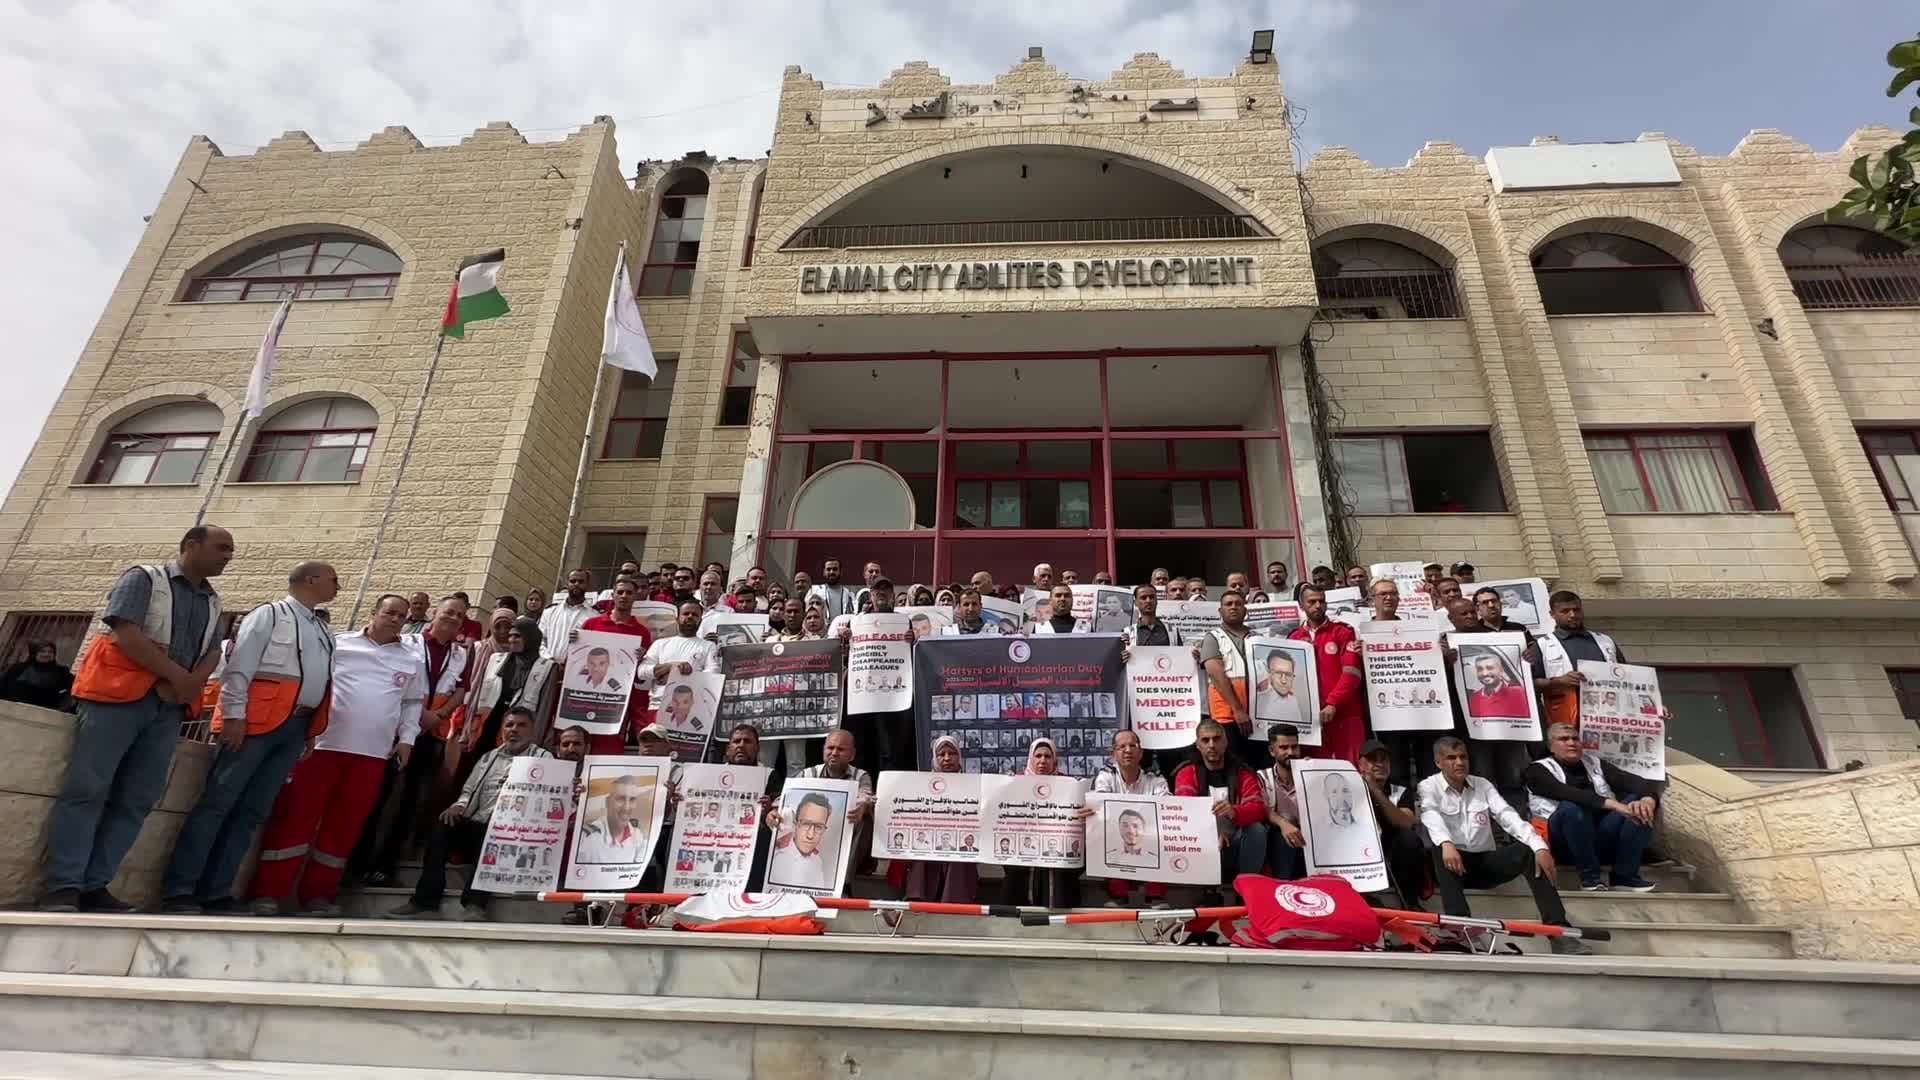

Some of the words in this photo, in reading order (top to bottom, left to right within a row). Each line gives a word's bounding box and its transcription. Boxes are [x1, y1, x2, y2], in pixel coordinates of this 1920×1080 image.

[894, 263, 951, 291] CITY
[954, 260, 1063, 290] ABILITIES
[1073, 257, 1253, 288] DEVELOPMENT
[853, 632, 904, 643] RELEASE
[1366, 641, 1432, 651] RELEASE
[853, 651, 888, 659] FORCIBLY
[852, 658, 905, 666] DISAPPEARED
[943, 666, 982, 676] Martyrs
[985, 665, 995, 674] of
[999, 663, 1074, 674] Humanitarian
[1078, 663, 1104, 673] Duty
[1370, 669, 1437, 677] DISAPPEARED
[1136, 699, 1195, 707] MEDICS
[1583, 714, 1618, 724] THEIR
[1622, 718, 1661, 728] SOULS
[1137, 721, 1197, 731] KILLED
[1624, 727, 1660, 735] JUSTICE
[1179, 835, 1198, 843] they
